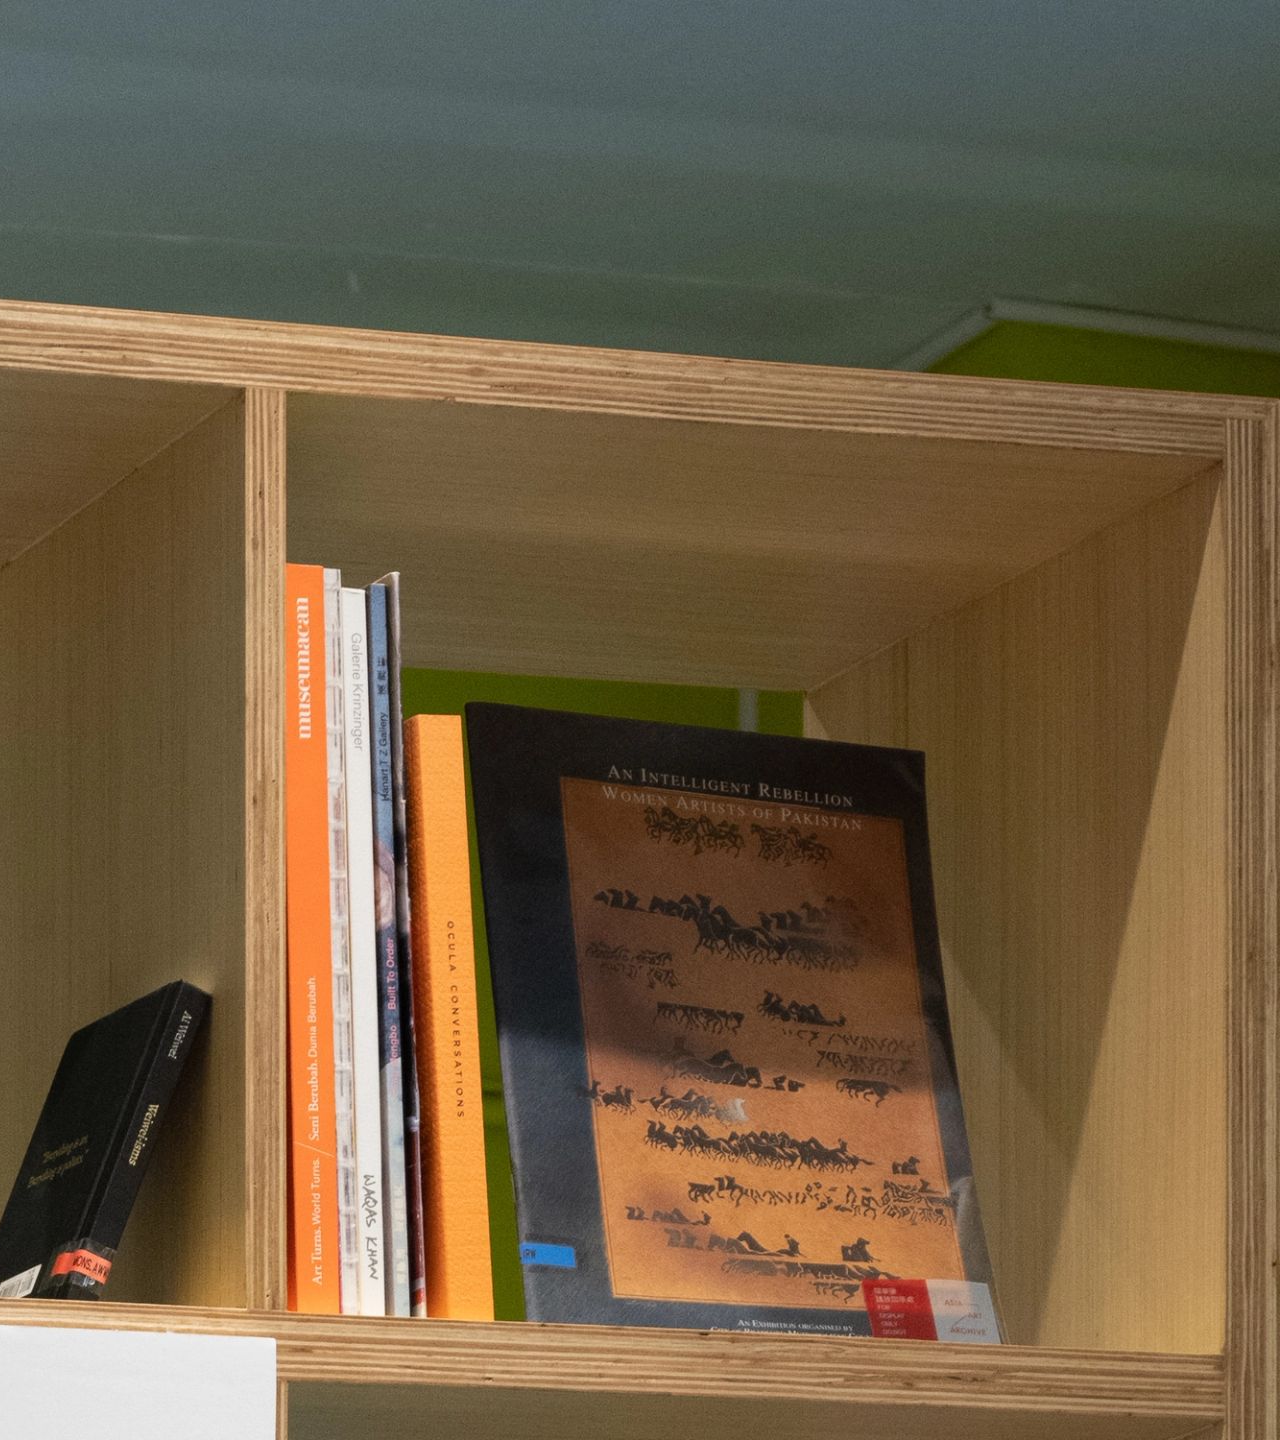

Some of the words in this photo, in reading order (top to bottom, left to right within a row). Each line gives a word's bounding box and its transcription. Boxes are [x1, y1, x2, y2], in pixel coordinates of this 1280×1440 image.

[295, 593, 312, 744] museumacan
[608, 765, 632, 779] AN
[641, 768, 750, 794] INTELLIGENT
[759, 782, 852, 806] REBELLION
[447, 921, 456, 971] OCULA
[450, 985, 464, 1117] CONVERSATIONS
